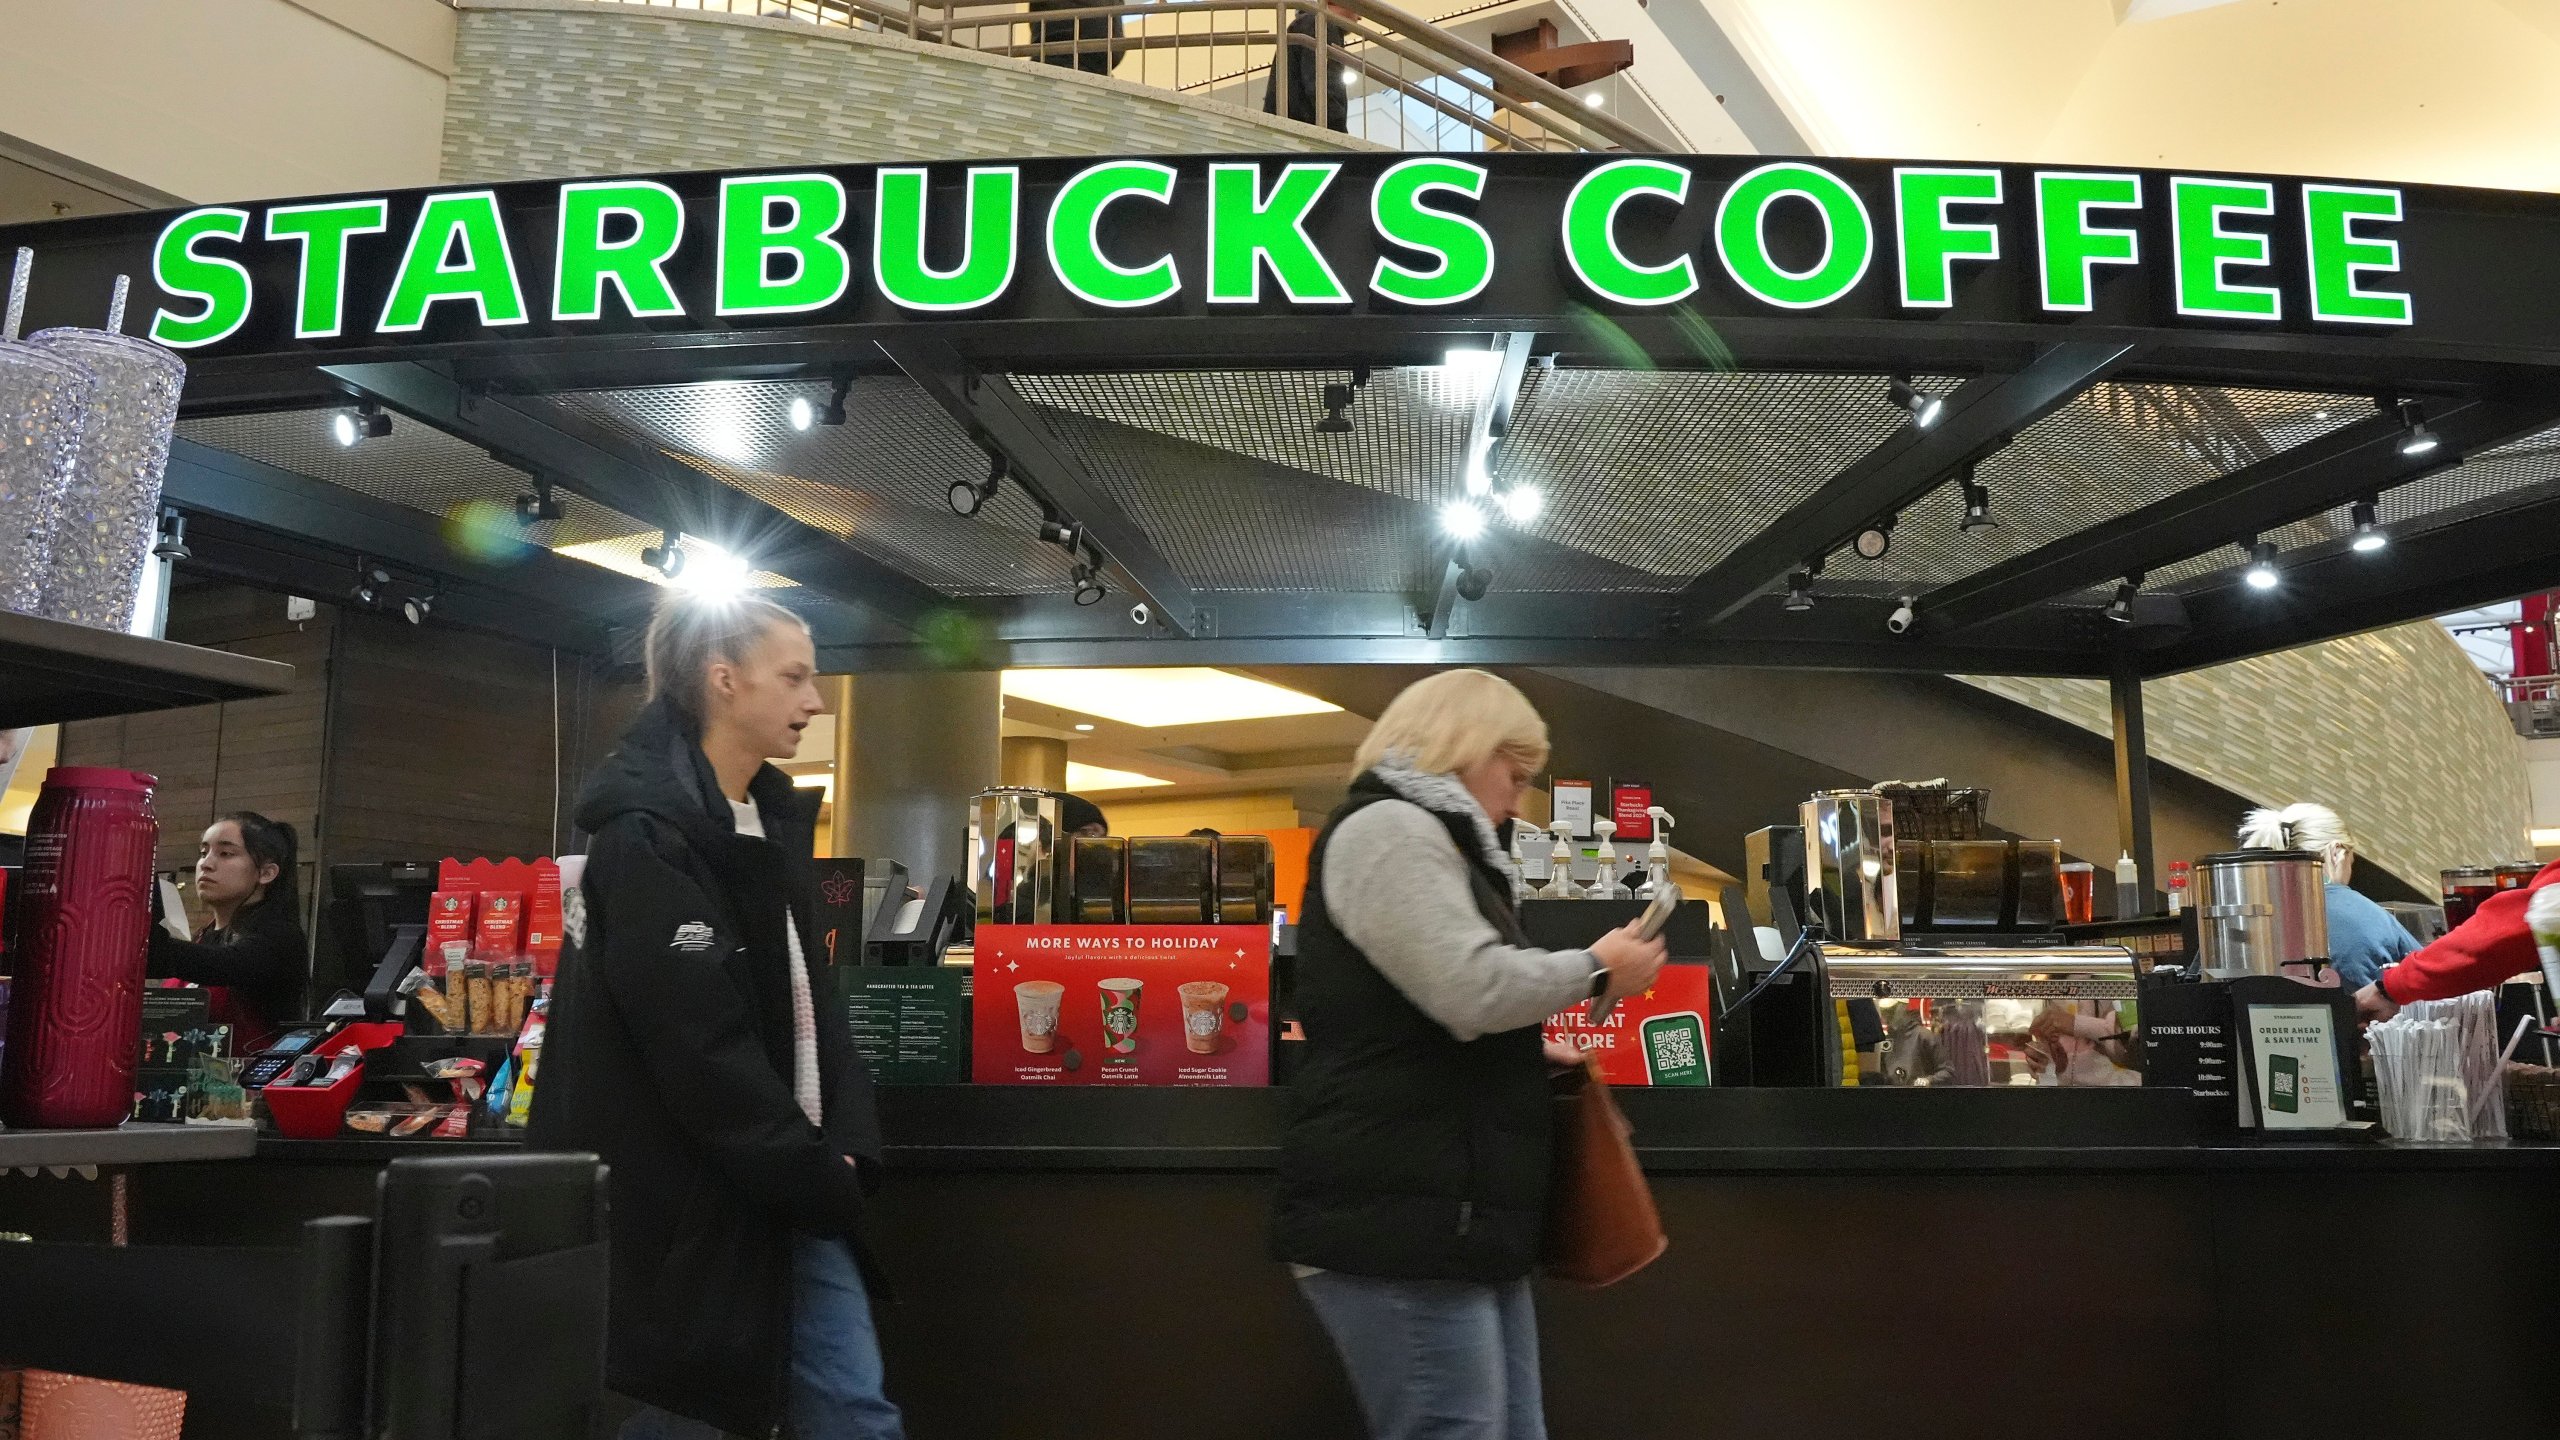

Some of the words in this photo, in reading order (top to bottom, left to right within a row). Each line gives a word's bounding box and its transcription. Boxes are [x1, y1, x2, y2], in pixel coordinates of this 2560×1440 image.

[148, 158, 1496, 349] STARBUCKS
[1561, 158, 2414, 326] COFFEE
[1026, 937, 1071, 949] MORE
[1076, 937, 1120, 949] WAYS
[1126, 937, 1146, 949] TO
[1151, 937, 1219, 949] HOLIDAY
[1602, 1013, 1626, 1028] AT
[2151, 1026, 2185, 1035] STORE
[2186, 1026, 2221, 1035] HOURS
[1554, 1032, 1615, 1049] STORE
